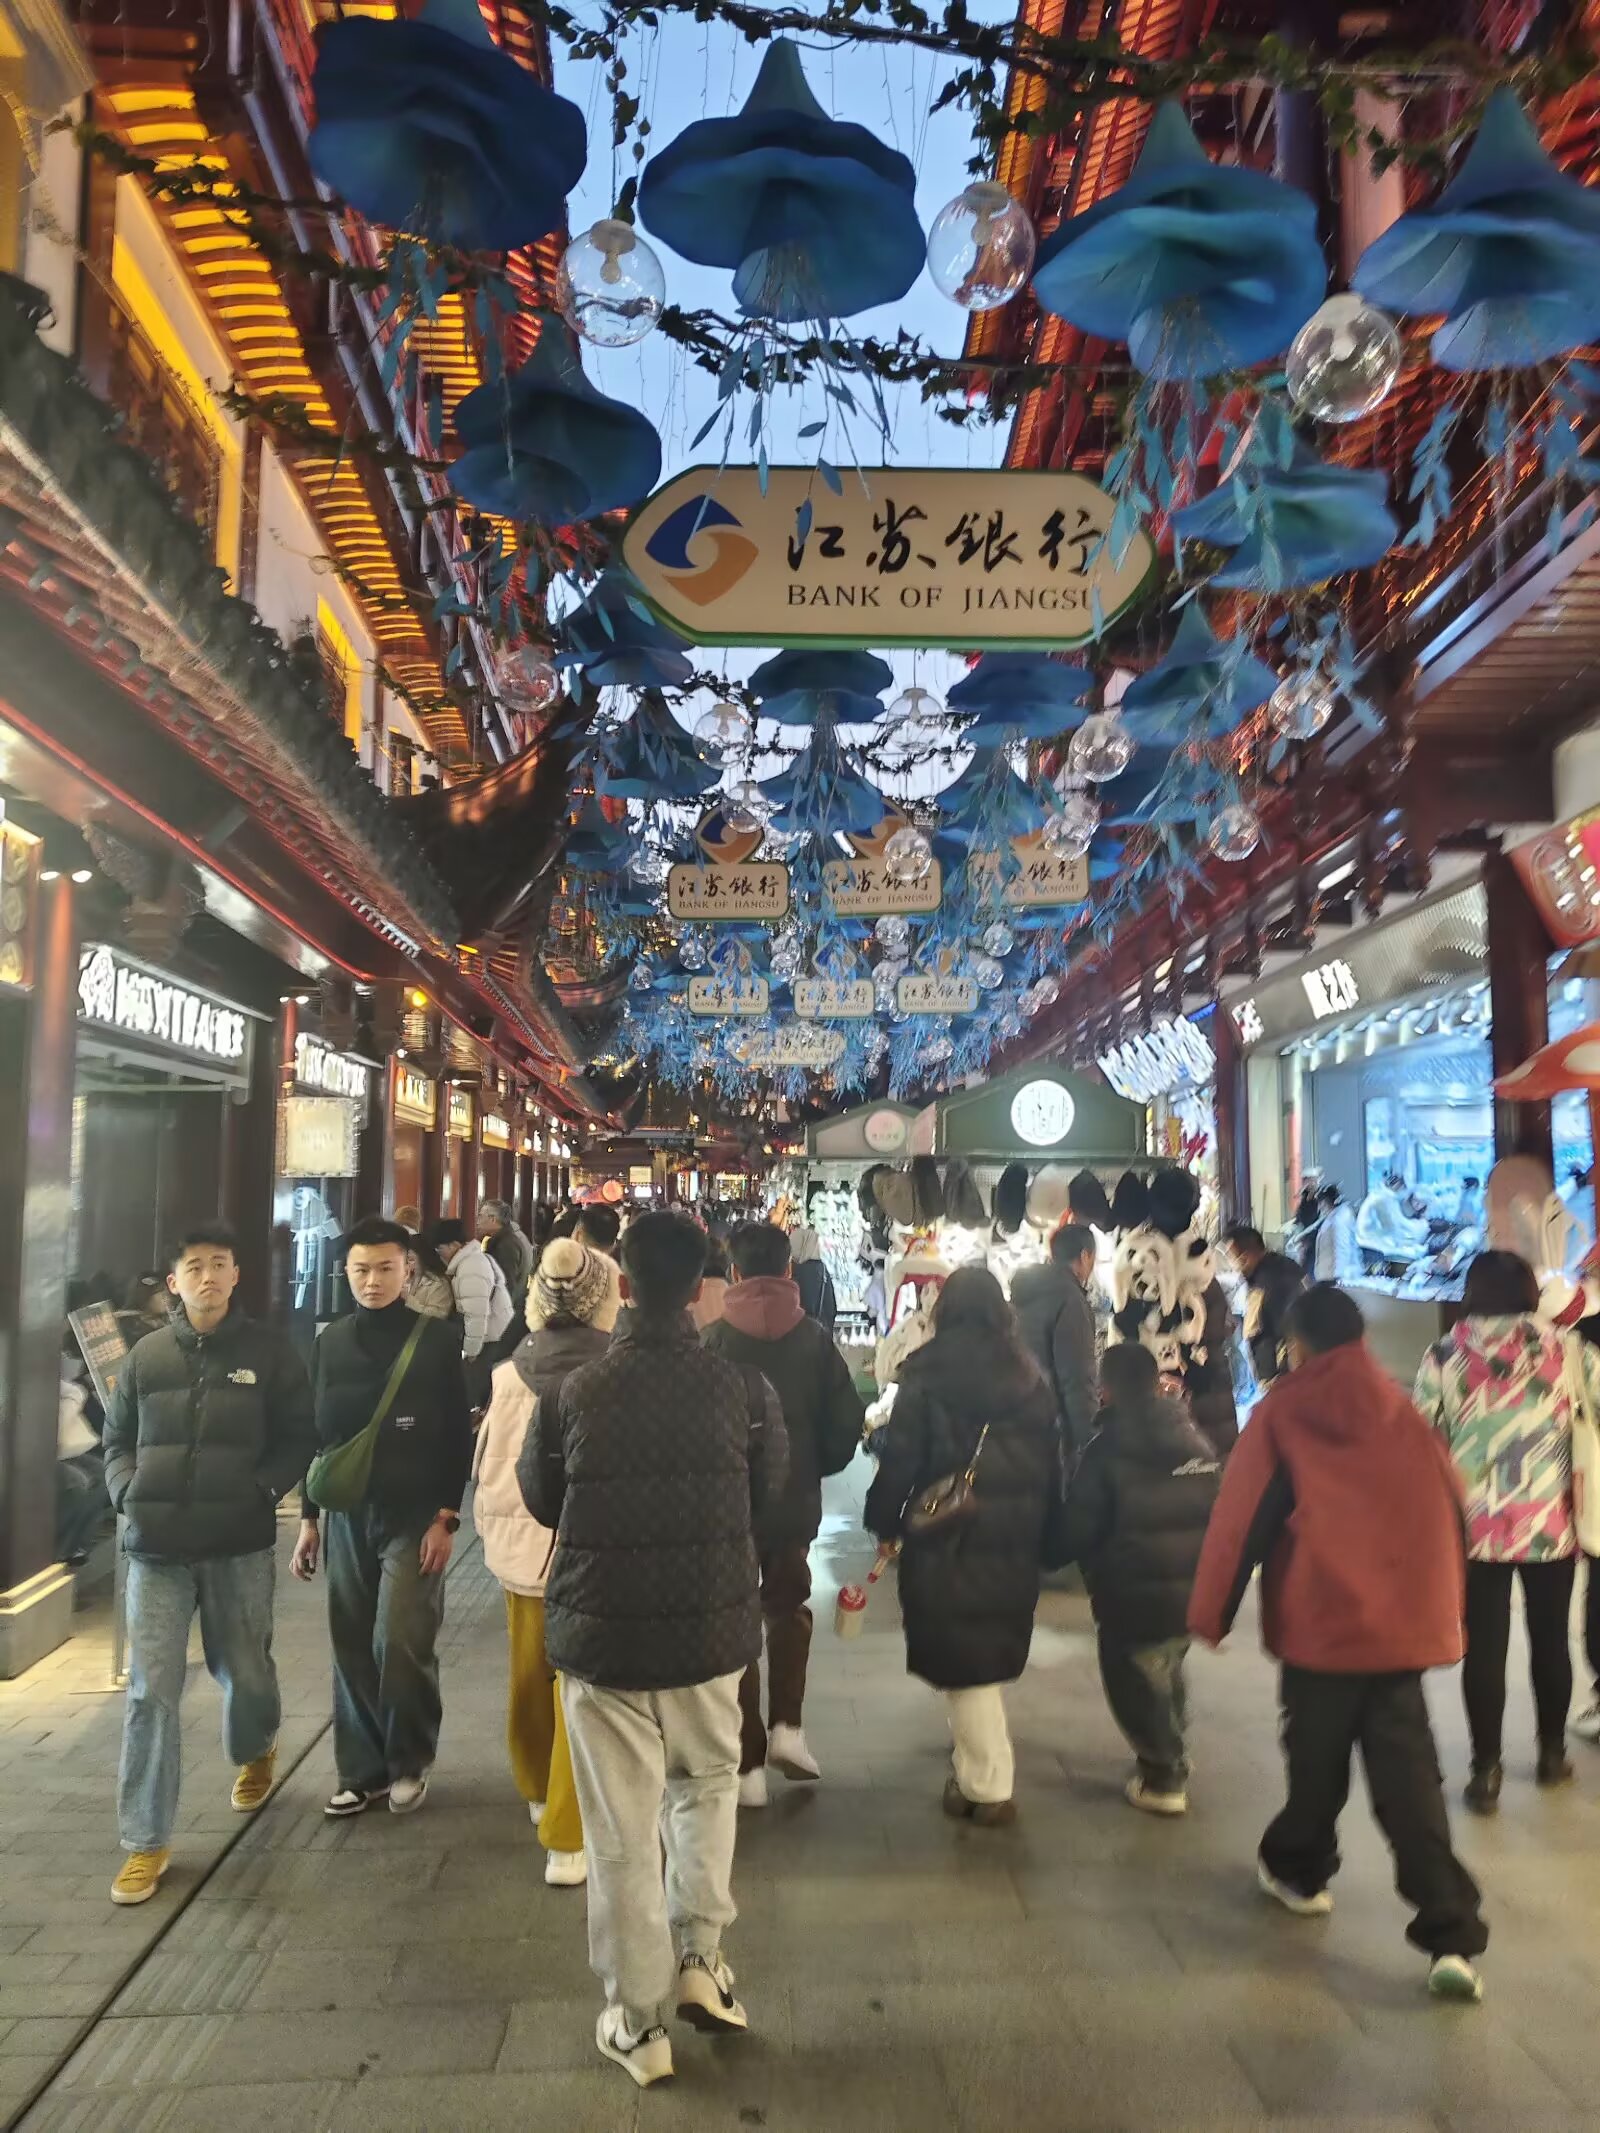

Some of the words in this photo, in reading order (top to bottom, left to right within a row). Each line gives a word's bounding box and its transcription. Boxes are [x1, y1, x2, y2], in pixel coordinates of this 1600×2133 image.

[787, 498, 1102, 577] 江苏银行
[787, 584, 881, 608] BANK
[899, 587, 942, 610] OF
[679, 873, 780, 898] 江苏银行
[714, 900, 729, 909] OF
